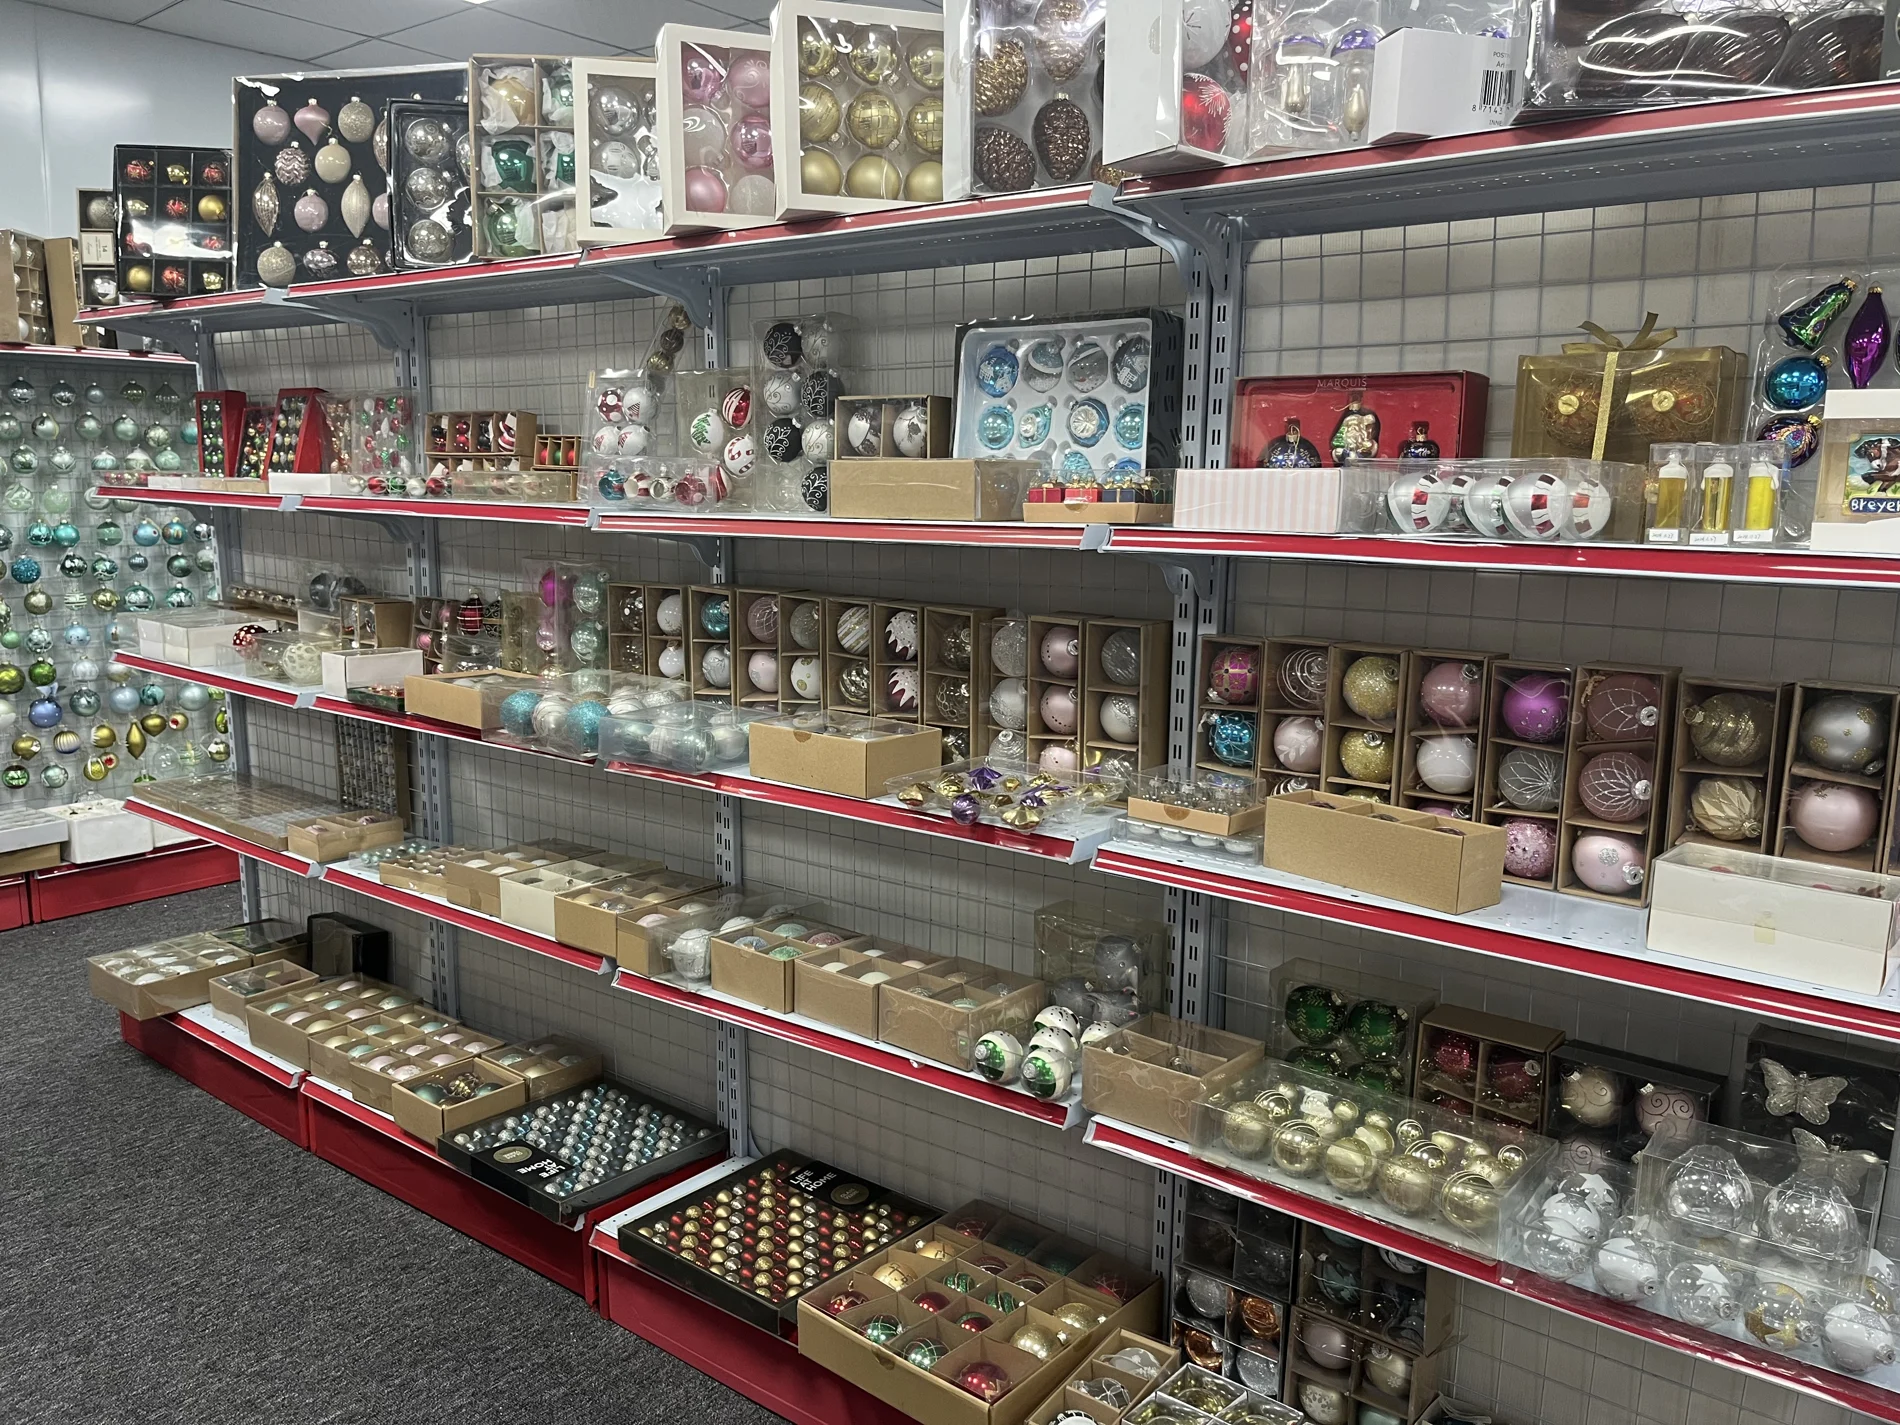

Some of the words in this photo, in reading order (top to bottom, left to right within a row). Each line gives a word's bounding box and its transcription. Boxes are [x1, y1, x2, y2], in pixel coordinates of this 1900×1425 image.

[1316, 377, 1368, 389] MARQUIS
[516, 1158, 553, 1174] HOME
[538, 1165, 566, 1178] LIFE
[544, 1161, 558, 1171] AT
[789, 1169, 814, 1185] LIFE
[799, 1177, 813, 1189] AT
[805, 1171, 837, 1192] HOME
